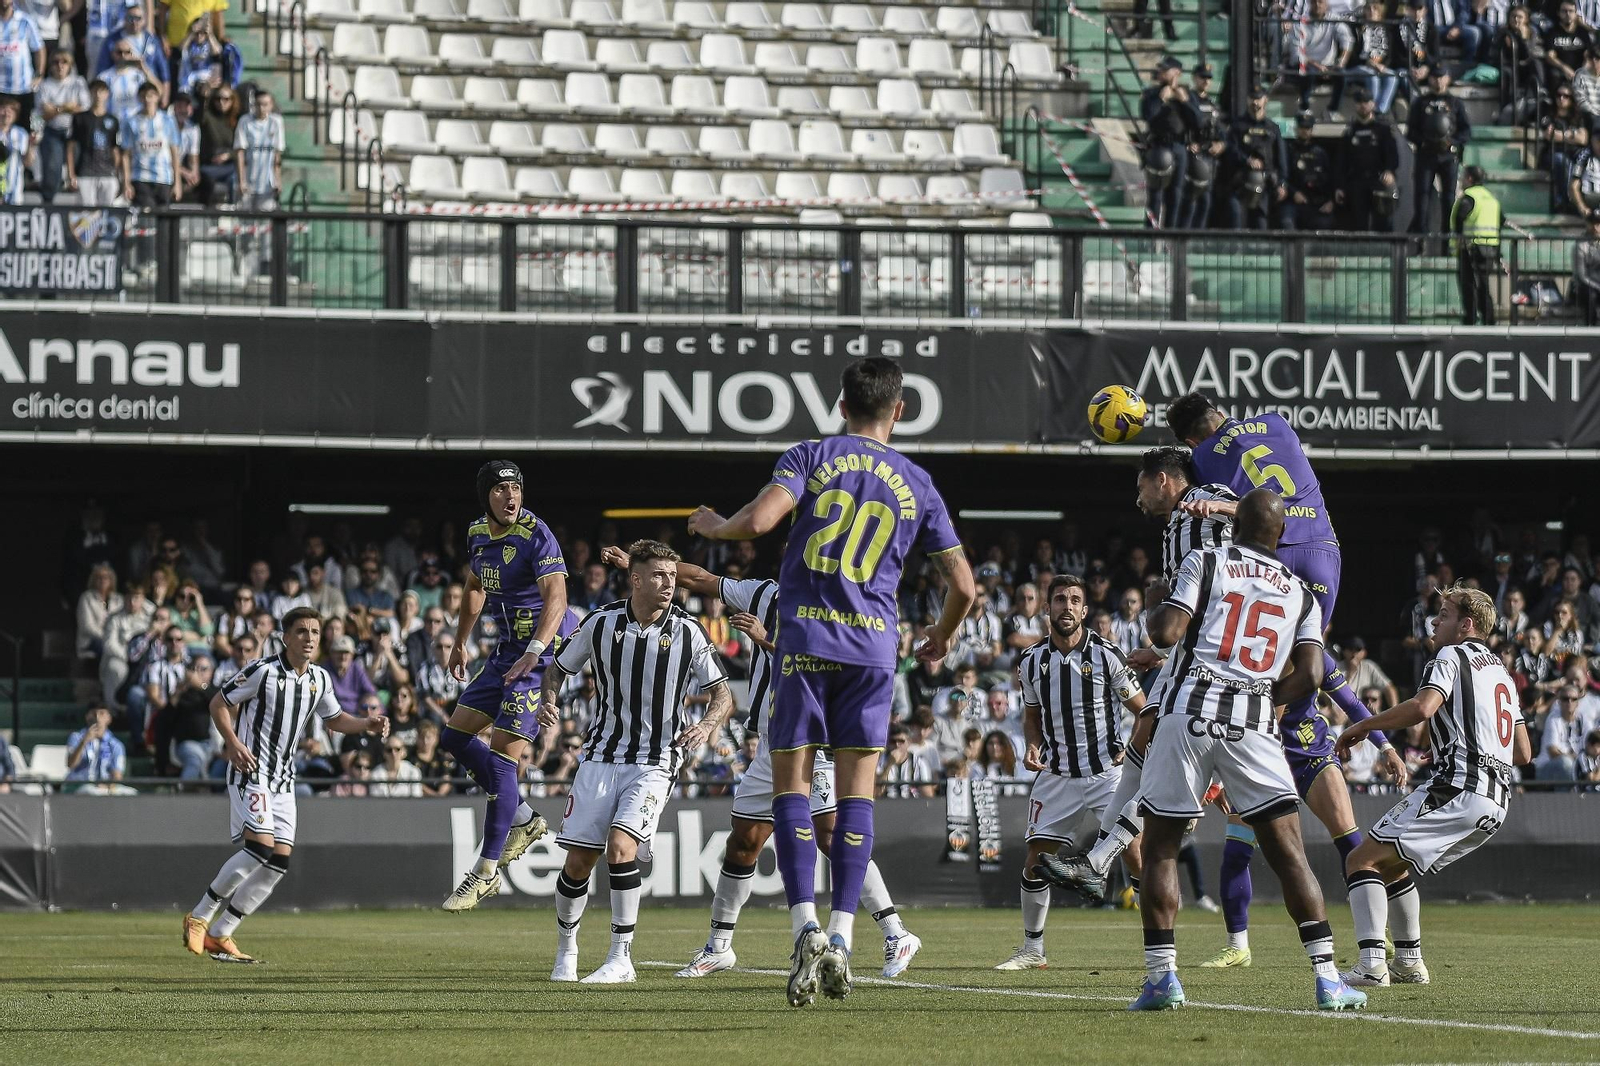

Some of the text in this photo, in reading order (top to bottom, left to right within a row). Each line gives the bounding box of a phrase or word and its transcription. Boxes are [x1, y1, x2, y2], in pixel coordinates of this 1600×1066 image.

[0, 207, 65, 249] PEÑA
[587, 331, 938, 357] electricidad
[1136, 346, 1591, 403] MARCIAL VICENT
[12, 391, 180, 421] clínica dental
[1213, 422, 1267, 455] PASTOR
[806, 453, 917, 521] NELSON MONTE
[1241, 444, 1296, 498] 5
[803, 489, 895, 583] 20
[1226, 563, 1291, 595] WILLEMS
[1312, 583, 1329, 595] SOL
[1216, 591, 1286, 673] 15
[795, 661, 842, 672] MÁLAGA
[1494, 683, 1512, 747] 6
[249, 793, 267, 812] 21
[1029, 798, 1043, 824] 17
